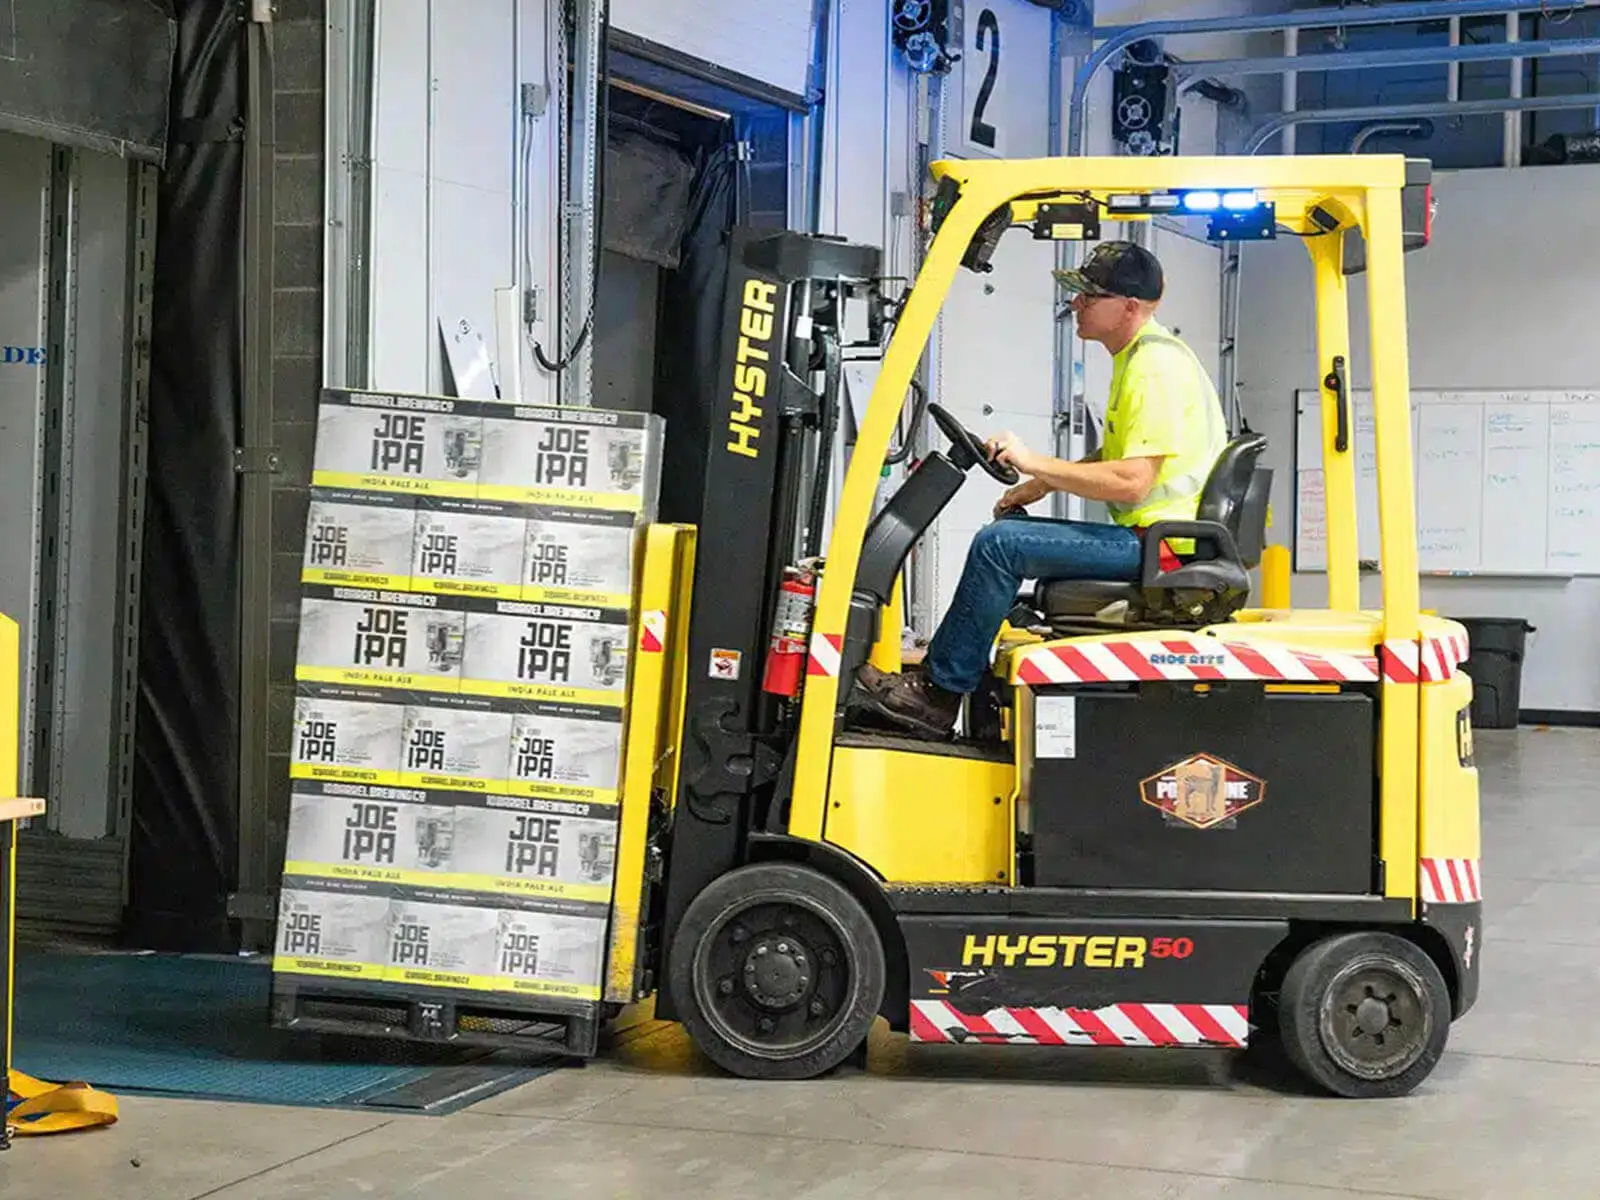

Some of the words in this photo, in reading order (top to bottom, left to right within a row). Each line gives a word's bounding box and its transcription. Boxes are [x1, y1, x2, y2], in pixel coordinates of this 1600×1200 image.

[970, 8, 999, 149] 2
[0, 346, 47, 364] DE
[727, 279, 777, 458] HYSTER
[374, 414, 426, 441] JOE
[538, 427, 590, 454] JOE
[371, 439, 424, 474] IPA
[536, 453, 588, 487] IPA
[312, 525, 348, 544] JOE
[423, 534, 458, 553] JOE
[311, 543, 346, 566] IPA
[420, 552, 456, 575] IPA
[533, 544, 568, 562] JOE
[531, 561, 566, 585] IPA
[357, 608, 409, 636] JOE
[520, 622, 572, 649] JOE
[354, 633, 407, 667] IPA
[518, 648, 570, 682] IPA
[301, 721, 336, 740] JOE
[410, 729, 445, 748] JOE
[299, 739, 335, 762] IPA
[408, 747, 444, 770] IPA
[519, 737, 554, 756] JOE
[517, 755, 553, 779] IPA
[346, 803, 398, 831] JOE
[509, 816, 561, 844] JOE
[343, 829, 396, 863] IPA
[506, 841, 558, 877] IPA
[286, 913, 321, 932] JOE
[394, 924, 430, 943] JOE
[284, 931, 320, 954] IPA
[392, 941, 428, 965] IPA
[504, 933, 539, 953] JOE
[962, 934, 1147, 968] HYSTER
[1150, 937, 1194, 959] 50
[501, 951, 537, 975] IPA
